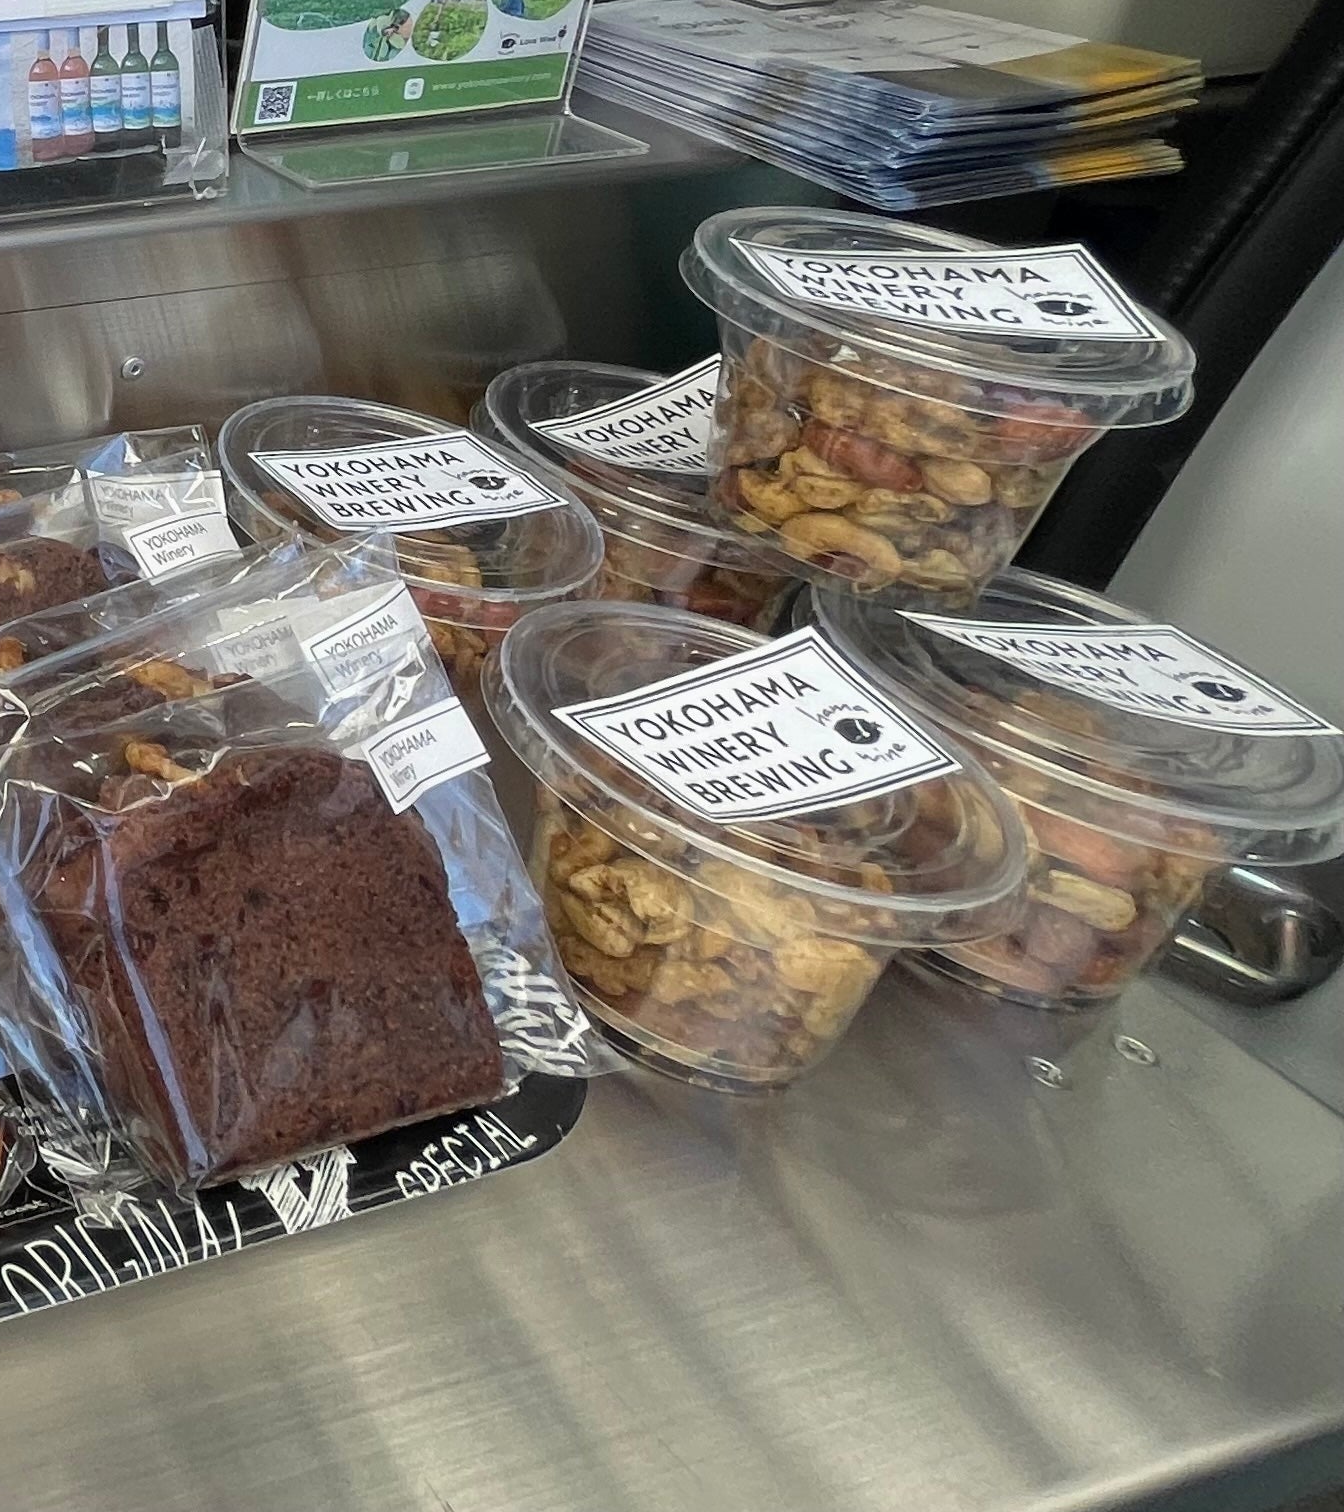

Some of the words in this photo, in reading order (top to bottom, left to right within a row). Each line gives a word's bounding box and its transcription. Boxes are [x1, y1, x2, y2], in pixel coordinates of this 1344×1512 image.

[767, 254, 1051, 284] YOKOHAMA
[786, 269, 966, 302] WINERY
[803, 286, 1024, 325] BREWING
[563, 387, 715, 445] YOKOHAMA
[594, 427, 700, 459] WINERY
[280, 449, 465, 479] YOKOHAMA
[302, 472, 427, 498] WINERY
[328, 490, 476, 519] BREWING
[143, 522, 209, 550] YOKOHAMA
[152, 543, 196, 566] Winery
[325, 614, 399, 661] YOKOHAMA
[606, 671, 821, 746] YOKOHAMA
[798, 702, 870, 727] hama
[645, 722, 790, 776] WINERY
[857, 741, 908, 765] wine
[684, 747, 854, 806] BREWING
